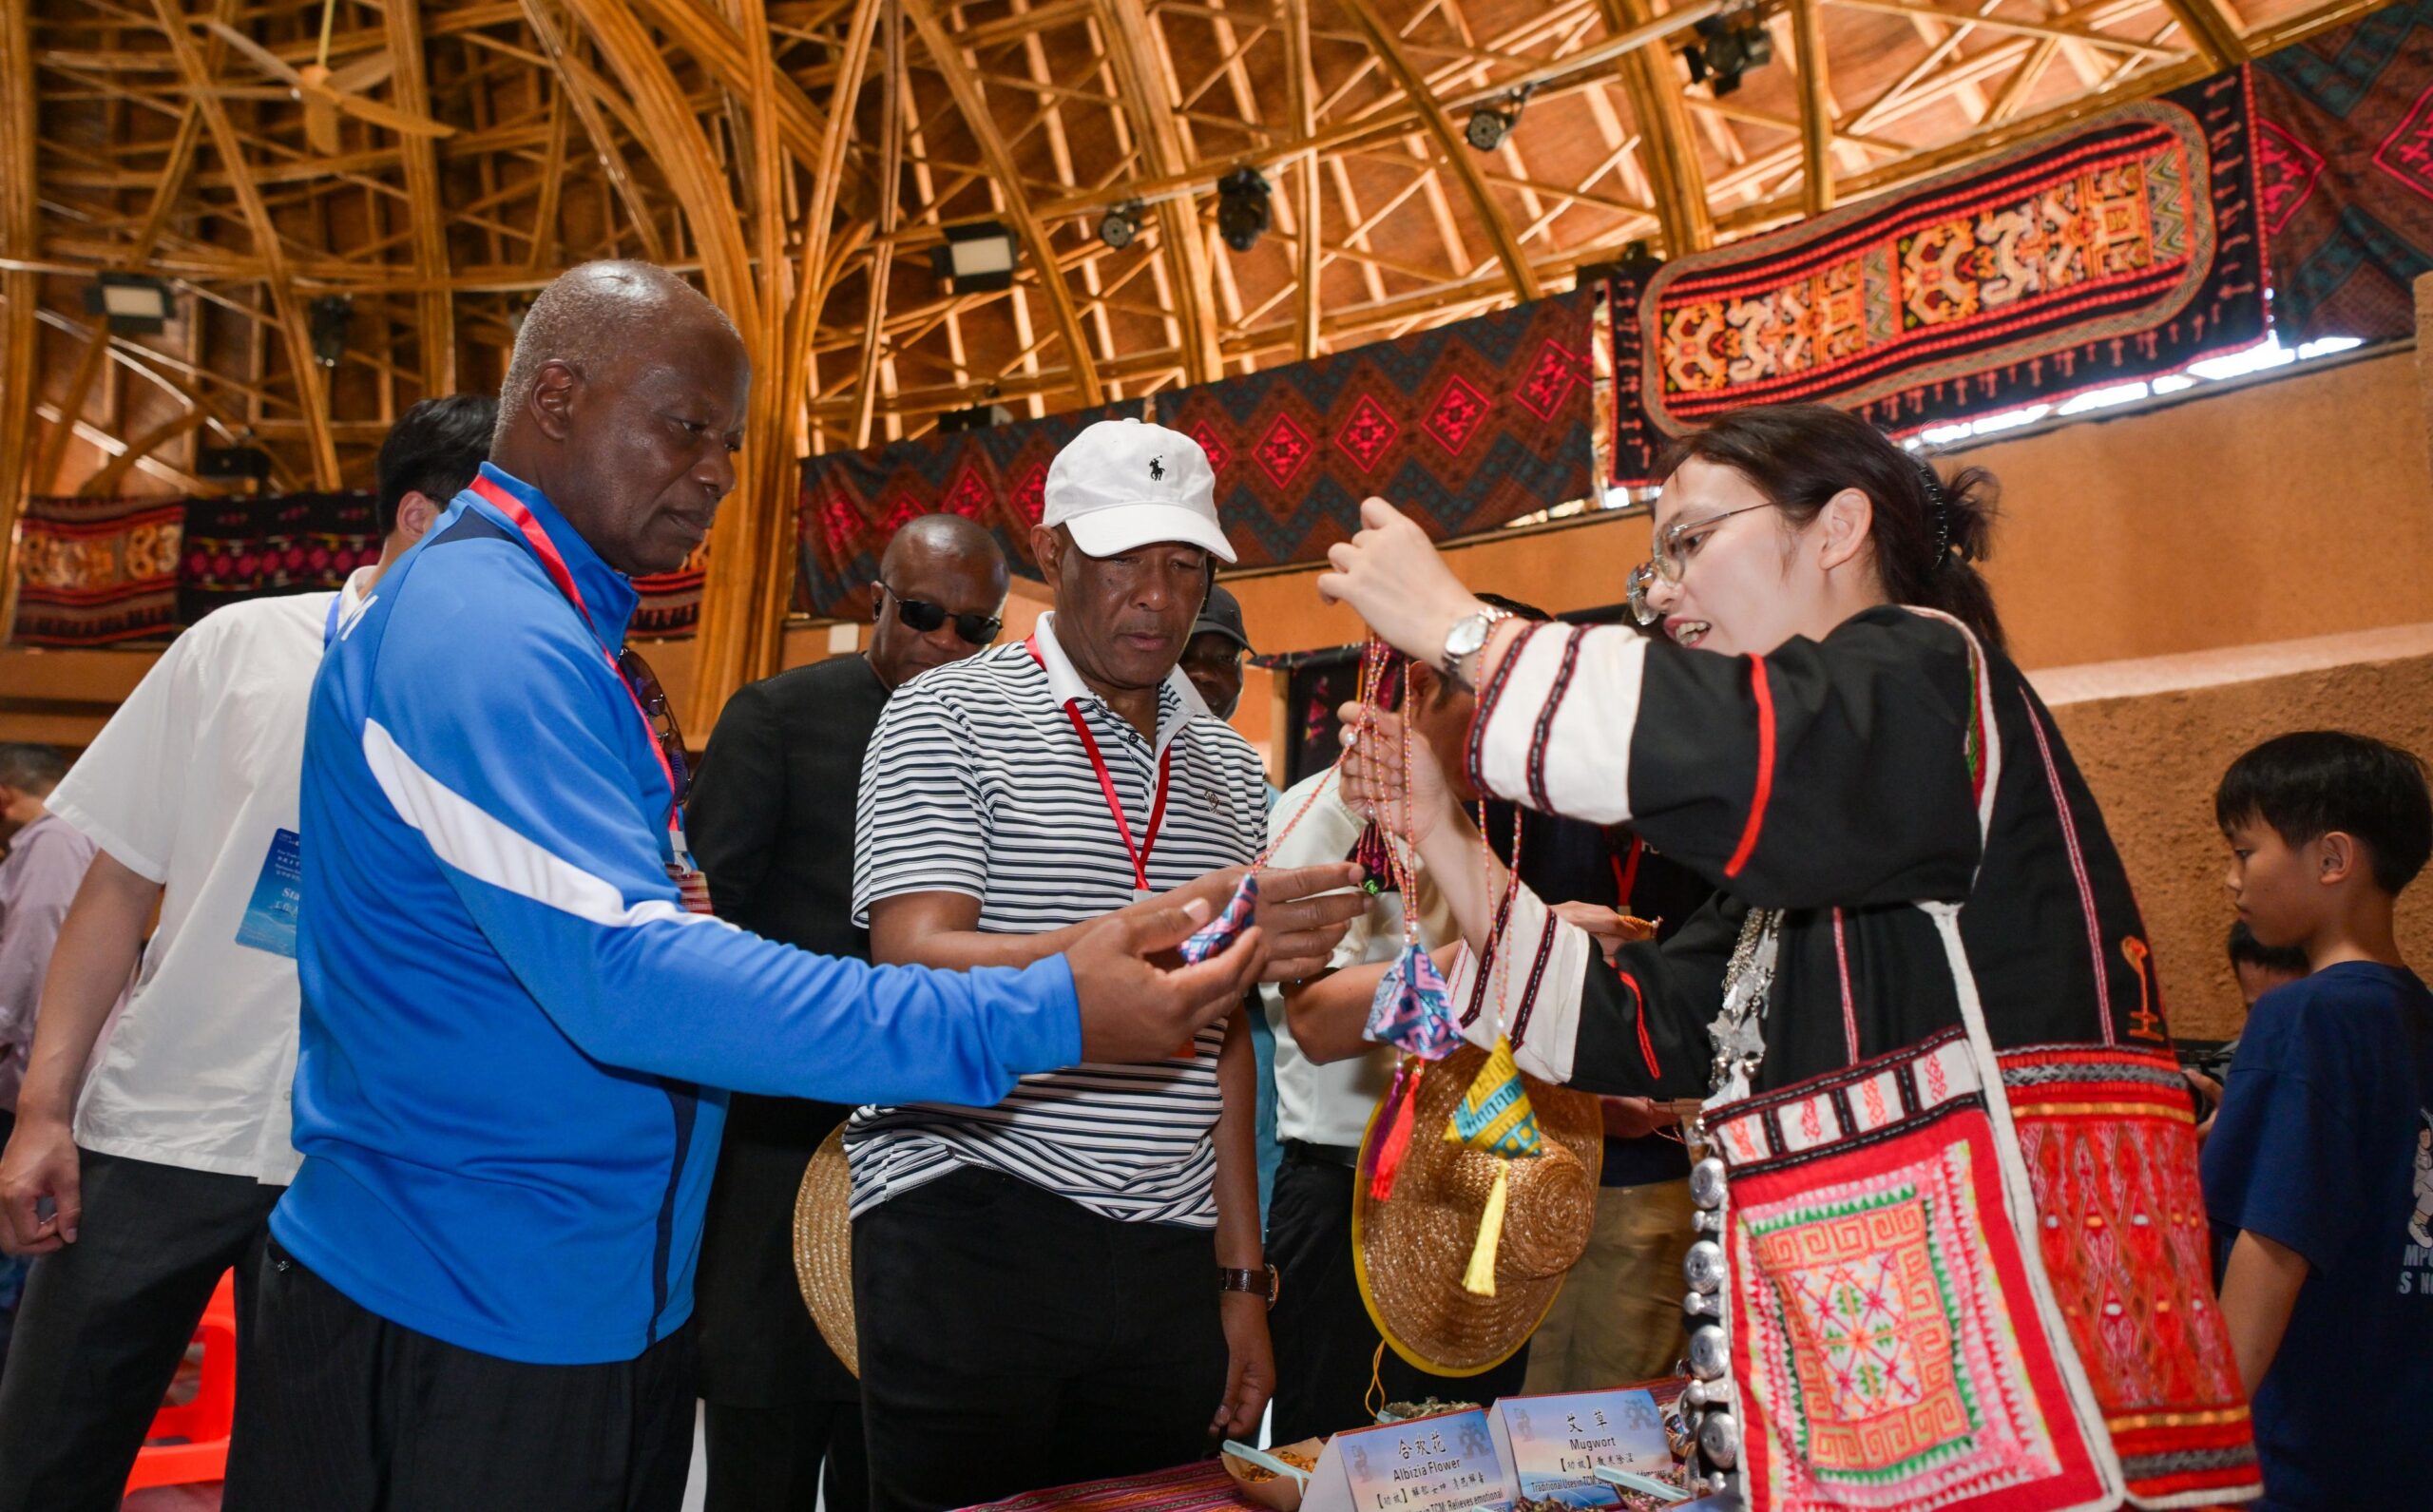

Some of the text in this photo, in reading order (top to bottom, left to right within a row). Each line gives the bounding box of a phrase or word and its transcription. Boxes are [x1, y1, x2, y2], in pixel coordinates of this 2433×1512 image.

[1398, 1429, 1446, 1460] 合欢花
[1569, 1437, 1617, 1452] Mugwort
[1393, 1459, 1460, 1483] Albizia Flower
[1531, 1479, 1561, 1493] Traditional
[1447, 1498, 1473, 1511] Relieves
[1474, 1488, 1504, 1504] emotional
